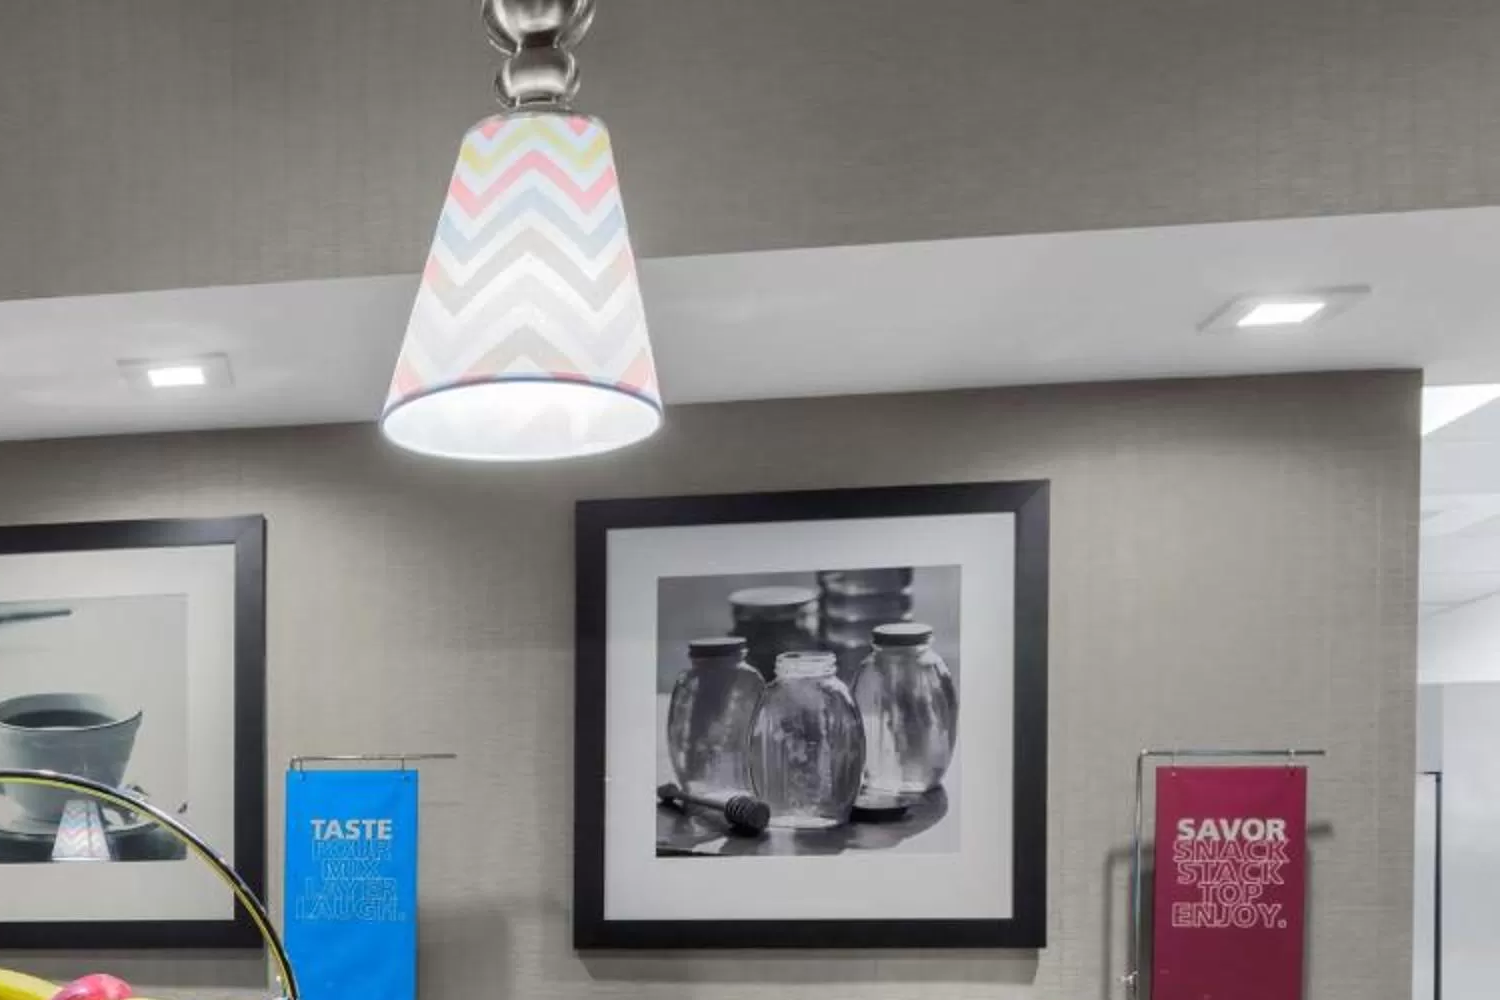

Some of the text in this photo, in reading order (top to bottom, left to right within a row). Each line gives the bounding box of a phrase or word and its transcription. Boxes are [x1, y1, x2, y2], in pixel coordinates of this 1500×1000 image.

[310, 818, 393, 840] TASTE
[1176, 818, 1287, 841] SAVOR
[1173, 839, 1290, 863] SNACK
[1176, 860, 1285, 884] STACK
[305, 877, 398, 900] LAYER
[1197, 882, 1263, 905] TOP
[1172, 902, 1288, 928] ENJOY.
